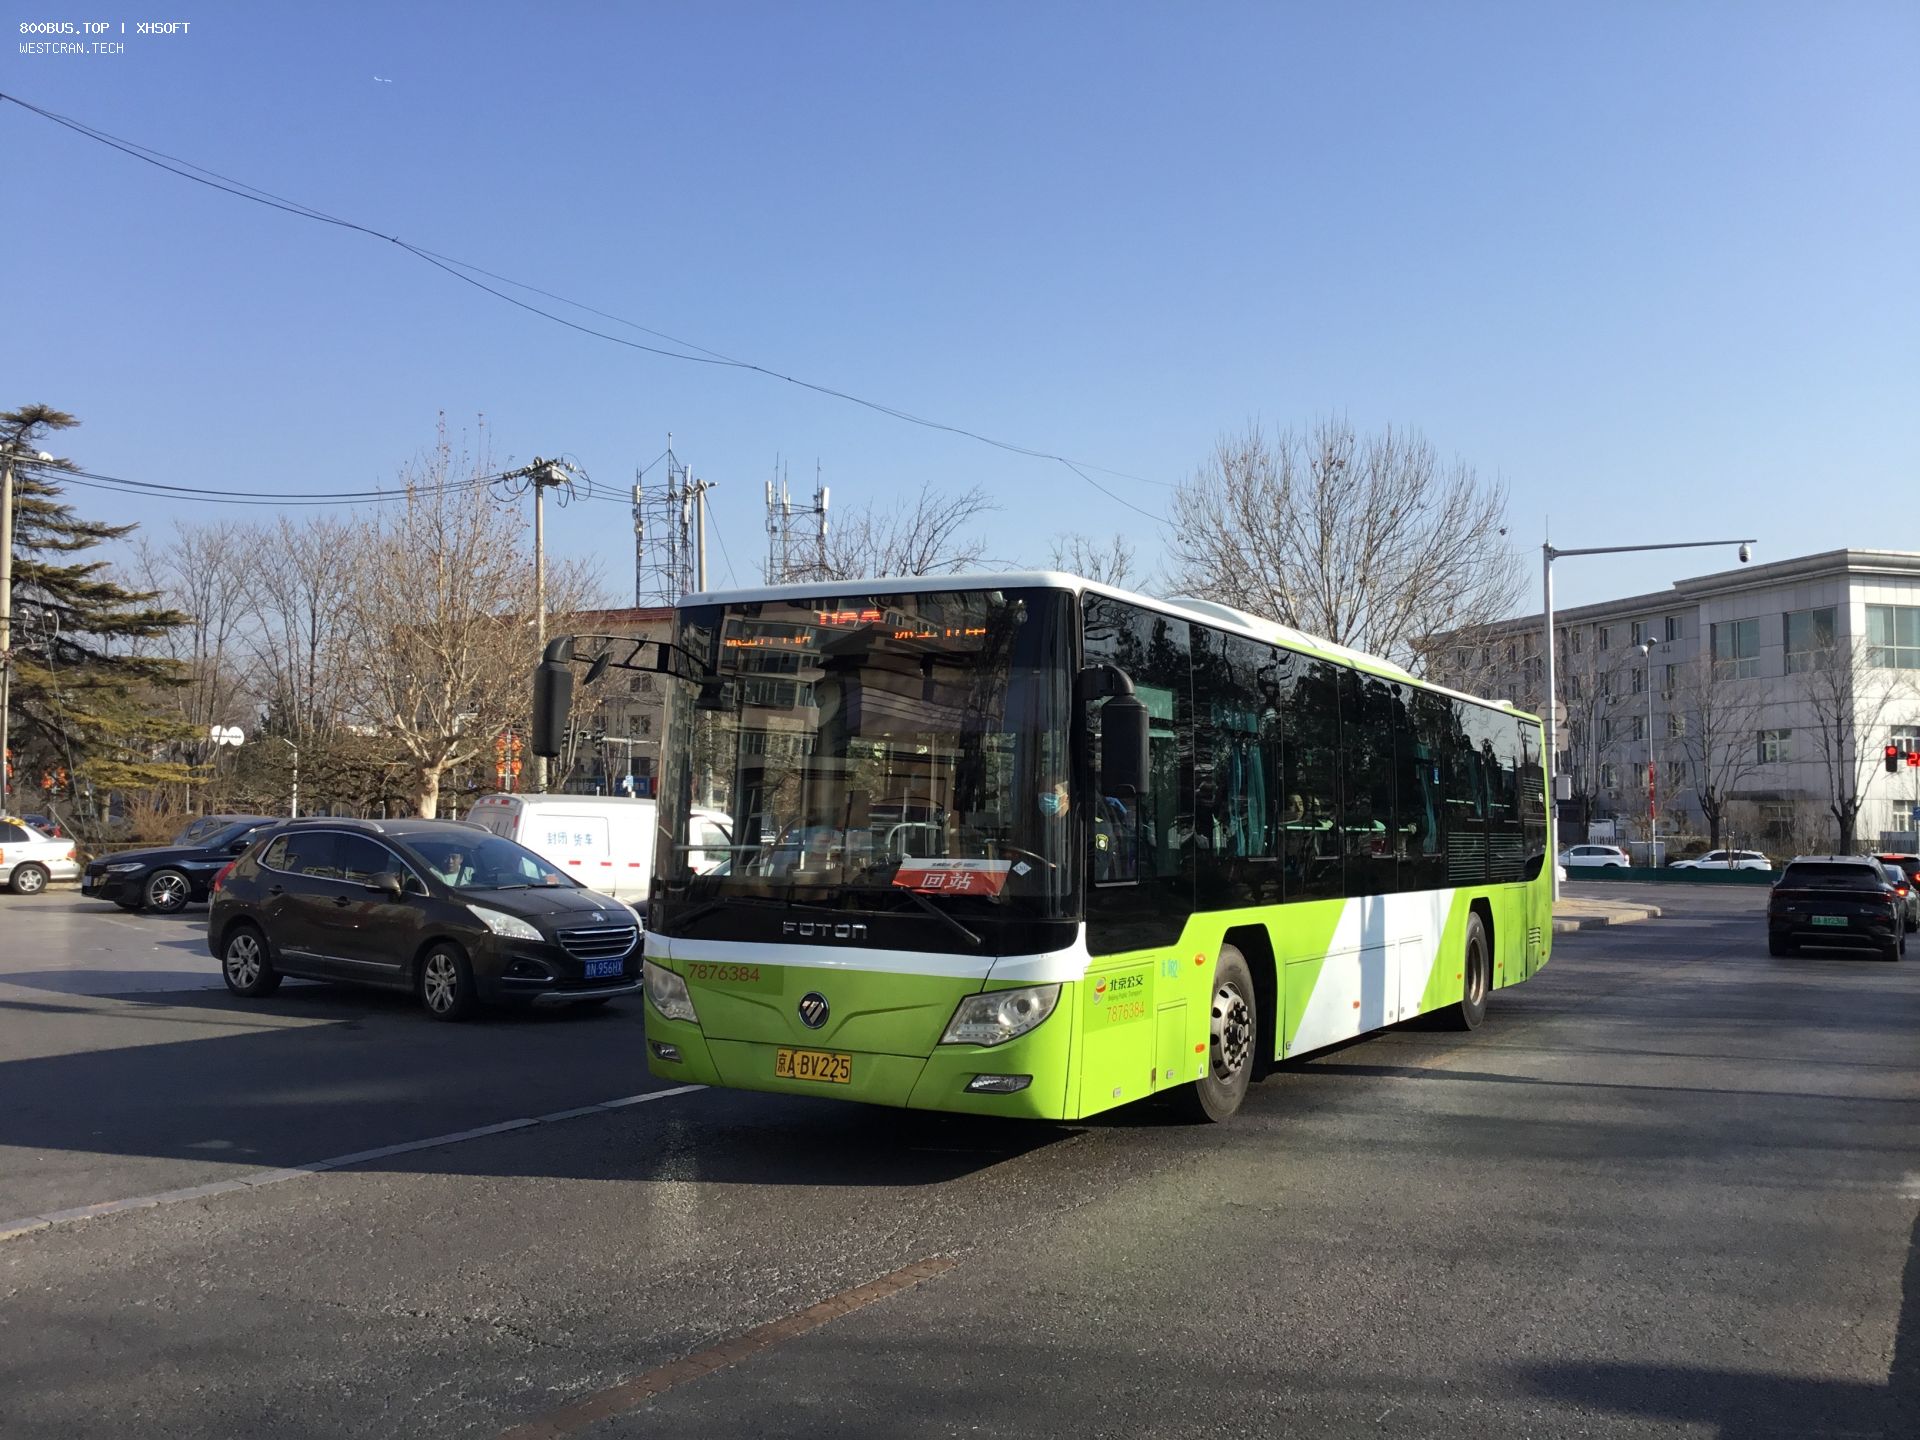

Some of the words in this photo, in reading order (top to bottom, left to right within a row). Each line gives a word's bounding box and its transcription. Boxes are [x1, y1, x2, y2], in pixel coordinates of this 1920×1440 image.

[920, 872, 975, 890] 回站
[782, 920, 867, 939] FOTON
[688, 963, 760, 983] 7876384
[1109, 974, 1143, 991] 北京公交
[1107, 1001, 1145, 1024] 7876384
